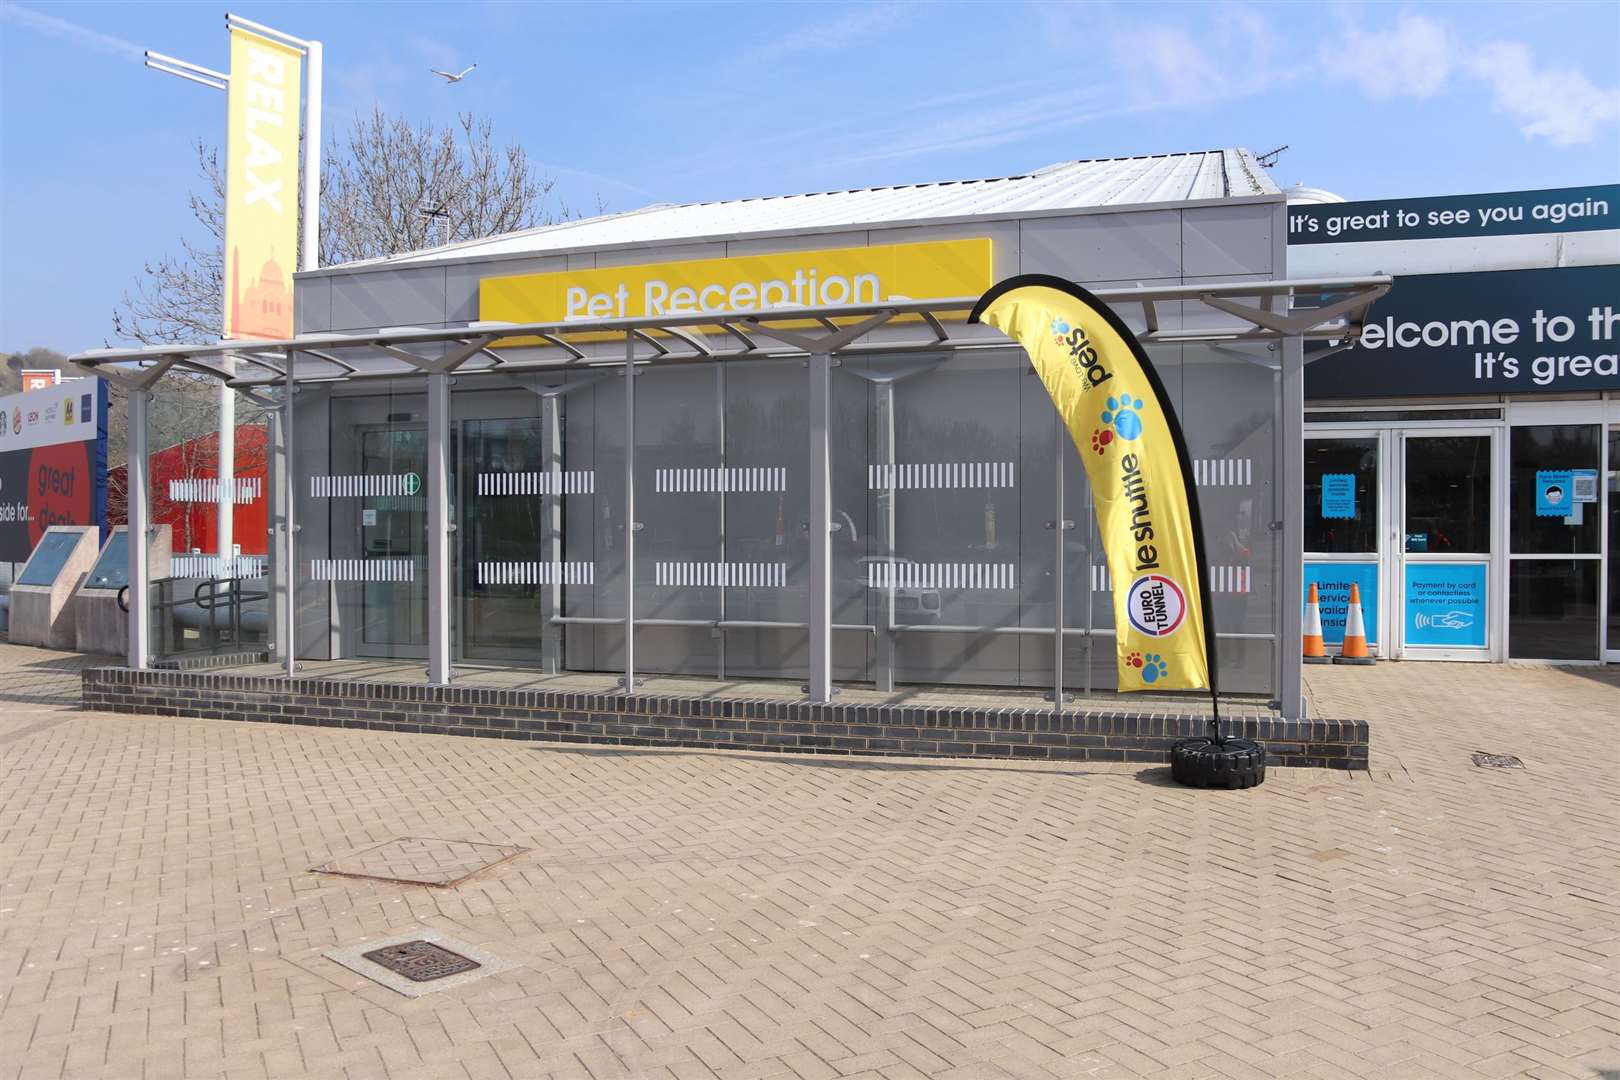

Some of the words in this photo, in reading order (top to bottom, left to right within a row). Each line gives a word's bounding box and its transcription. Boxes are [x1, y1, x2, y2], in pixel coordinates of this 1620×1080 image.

[244, 47, 285, 213] RELAX
[1290, 214, 1319, 233] It's
[1326, 210, 1389, 236] great
[1396, 209, 1420, 227] to
[1427, 208, 1470, 226] see
[1478, 205, 1523, 227] you
[1531, 198, 1609, 223] again
[566, 283, 629, 318] Pet
[644, 268, 881, 316] Reception
[1358, 316, 1520, 350] elcome
[1531, 310, 1576, 342] to
[1065, 328, 1113, 388] pets
[1474, 351, 1520, 379] It's
[1531, 353, 1618, 386] grea
[1317, 581, 1359, 591] Limite
[1412, 582, 1446, 590] Payment
[1447, 582, 1457, 590] by
[1140, 590, 1156, 623] EURO
[1151, 582, 1169, 630] TUNNEL
[1320, 617, 1348, 627] insid
